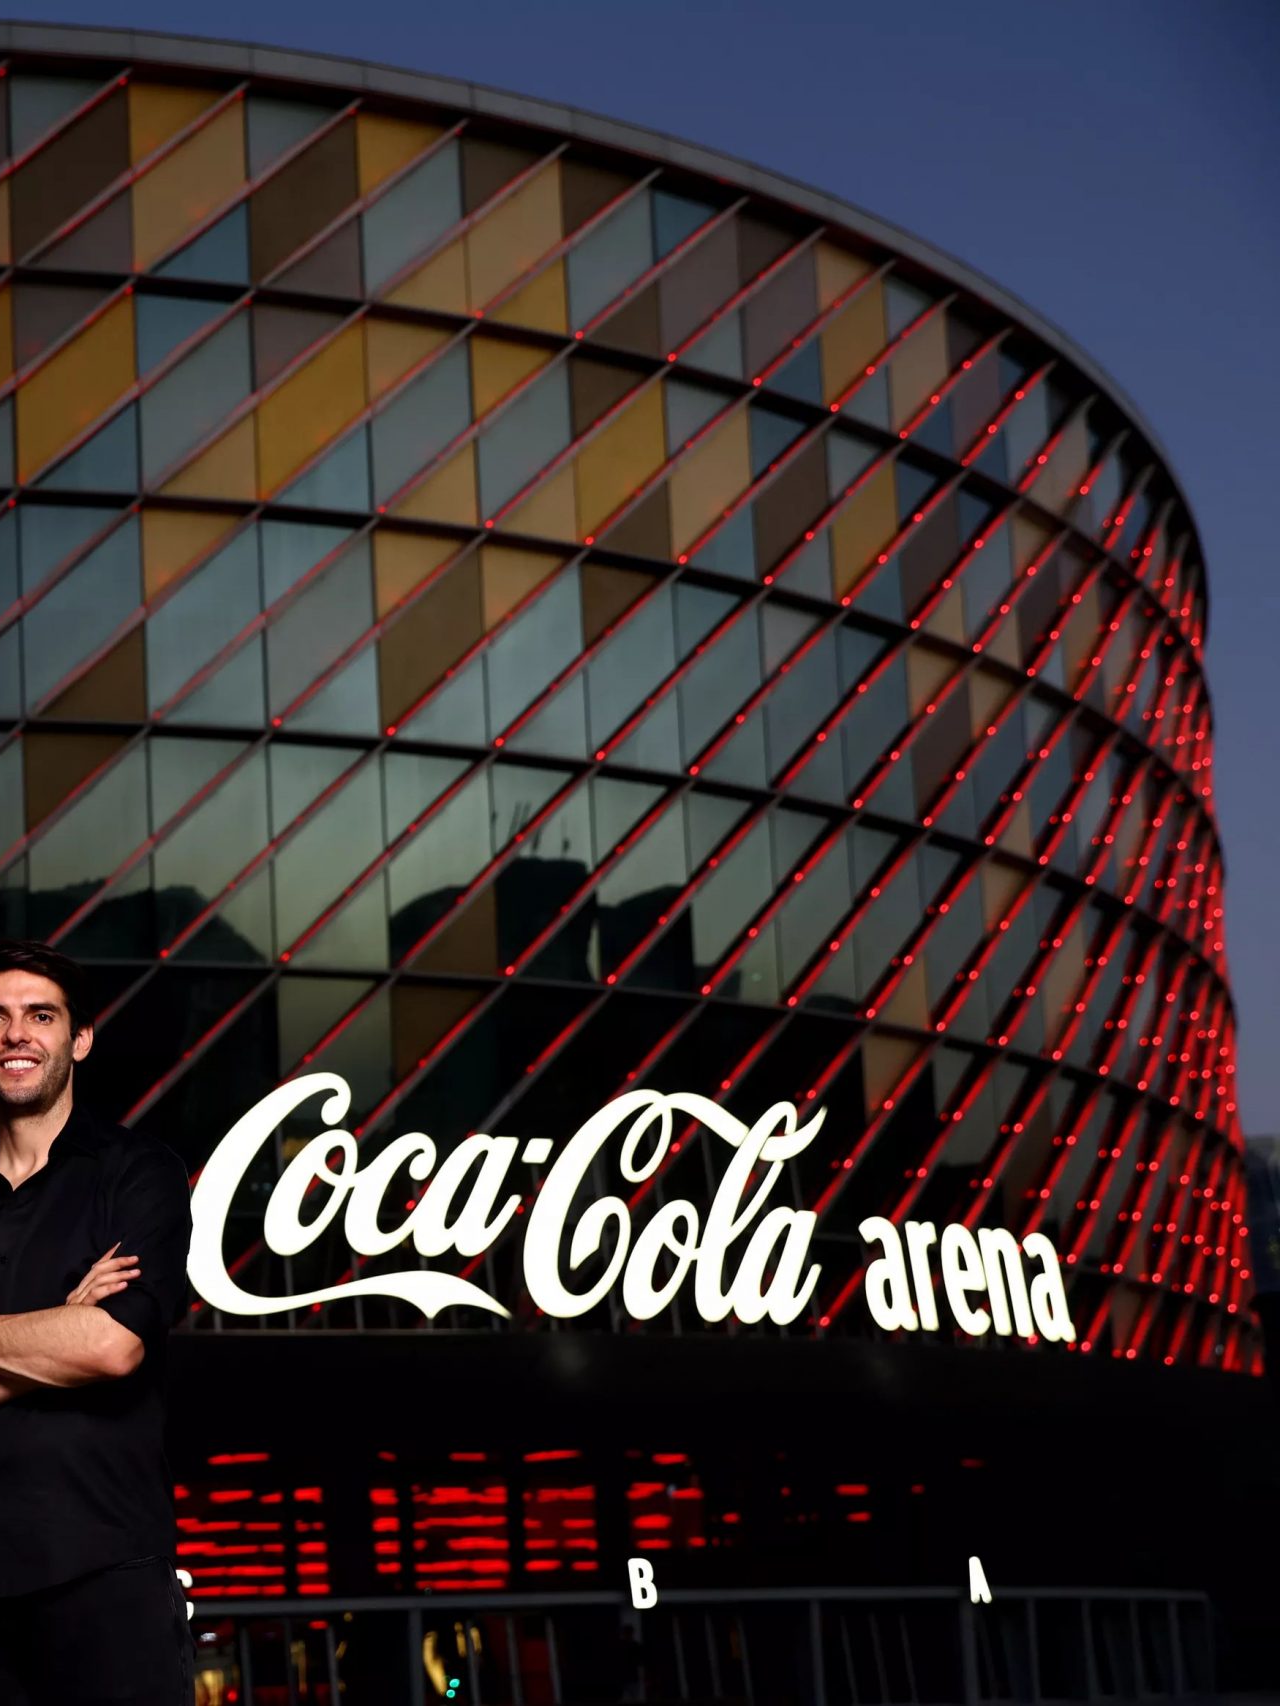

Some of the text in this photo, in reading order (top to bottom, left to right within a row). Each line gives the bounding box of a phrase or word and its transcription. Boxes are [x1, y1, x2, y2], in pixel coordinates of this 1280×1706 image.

[187, 1072, 1076, 1342] Coca-Cola arena
[627, 1557, 658, 1609] B
[968, 1556, 992, 1604] A
